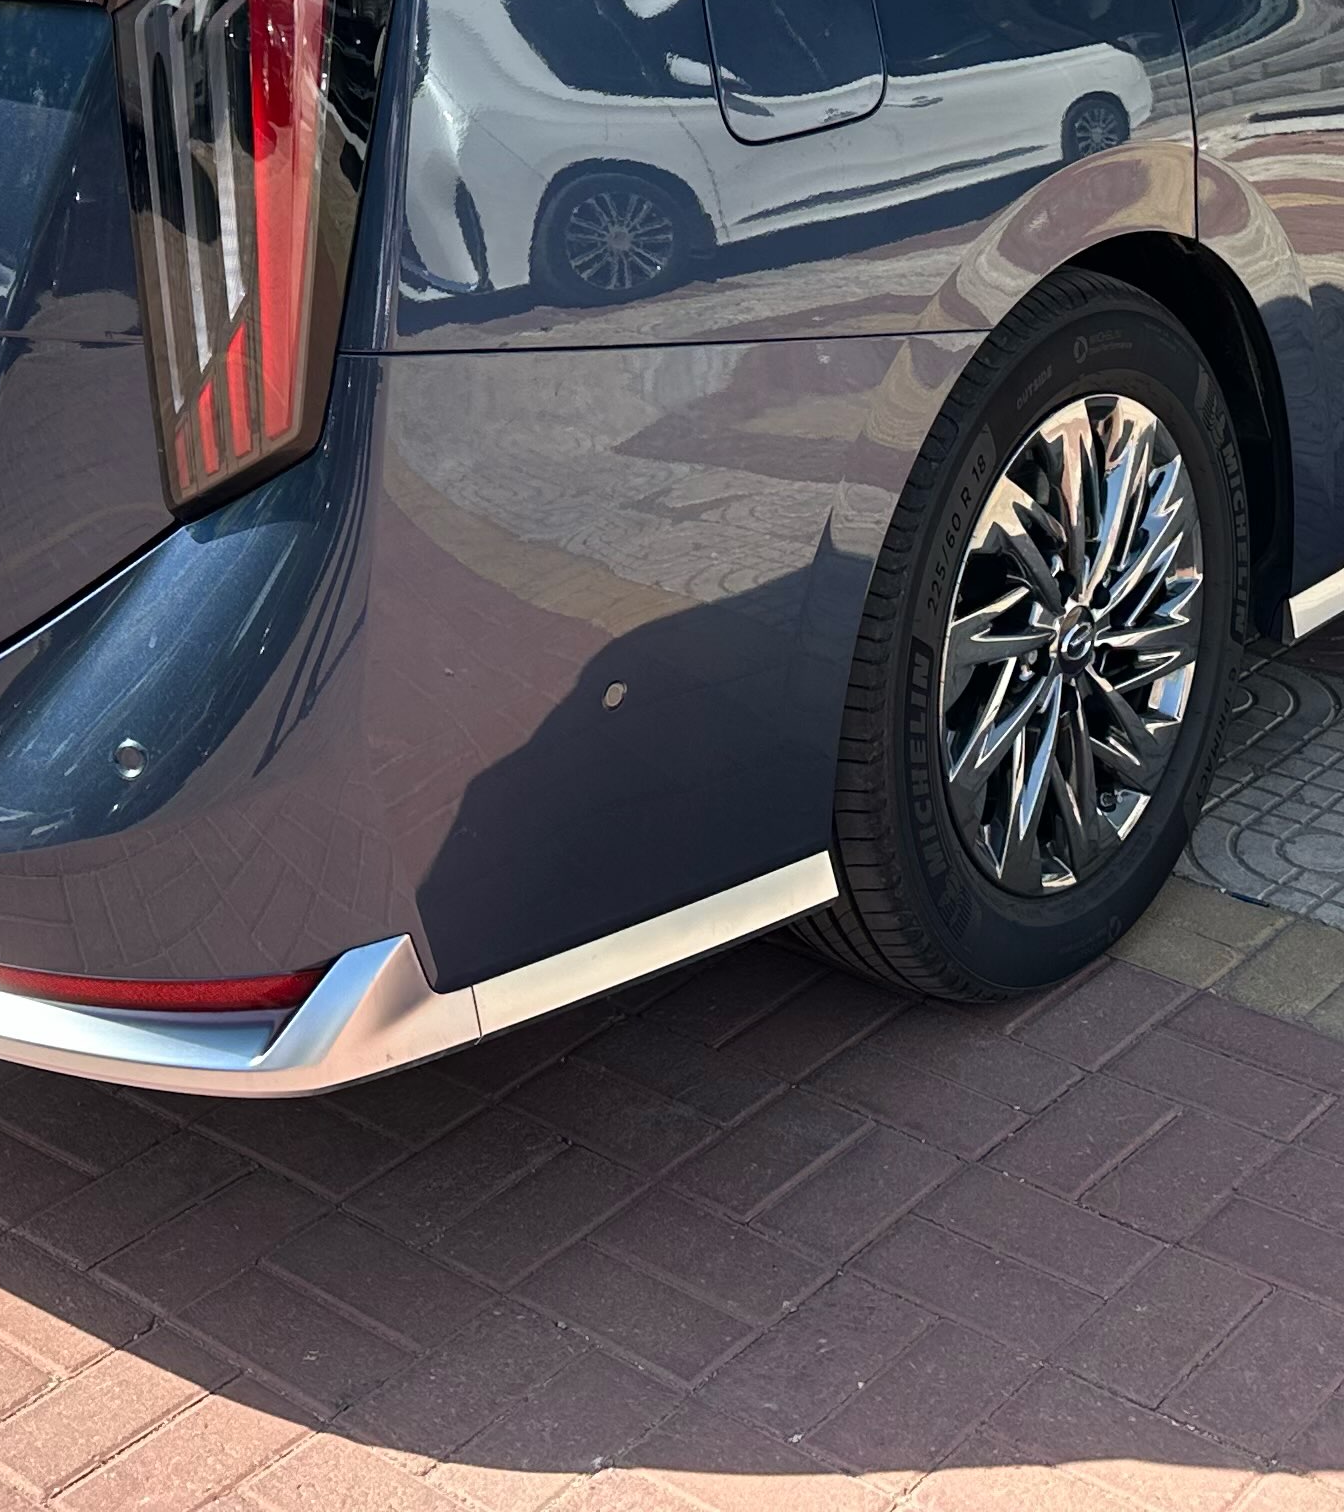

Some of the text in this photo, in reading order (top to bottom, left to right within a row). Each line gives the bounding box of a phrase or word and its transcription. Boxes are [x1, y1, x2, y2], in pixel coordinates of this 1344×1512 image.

[926, 453, 989, 617] 225/60 R 18
[1221, 441, 1248, 632] MICHELIN
[909, 653, 948, 874] MICHELIN
